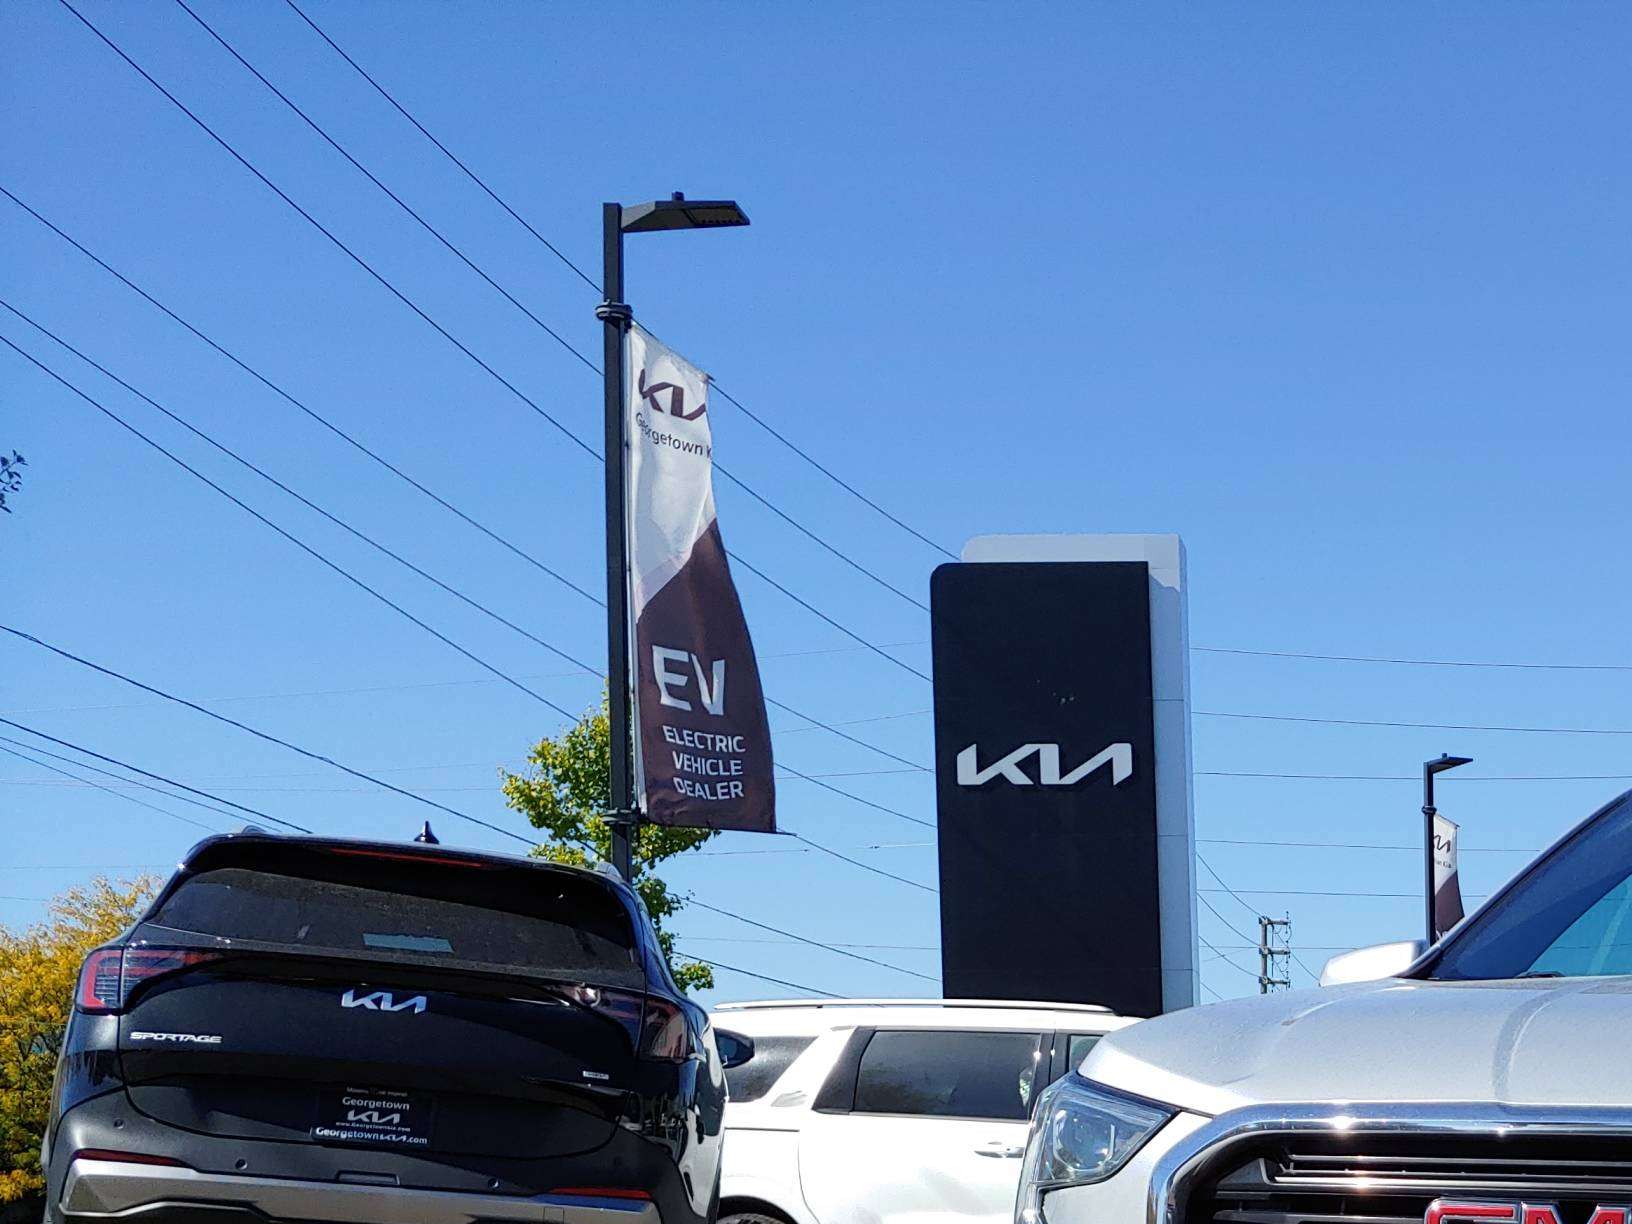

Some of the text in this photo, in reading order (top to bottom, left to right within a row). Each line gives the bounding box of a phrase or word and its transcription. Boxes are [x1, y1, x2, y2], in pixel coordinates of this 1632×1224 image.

[652, 645, 725, 716] EV
[662, 725, 746, 753] ELECTRIC
[672, 750, 744, 776] VEHICLE
[956, 743, 1133, 786] KIA
[672, 777, 744, 801] DEALER
[341, 989, 427, 1014] KIA
[129, 1031, 222, 1043] SPORTAGE
[342, 1096, 410, 1111] Georgetown
[347, 1109, 401, 1125] KIA
